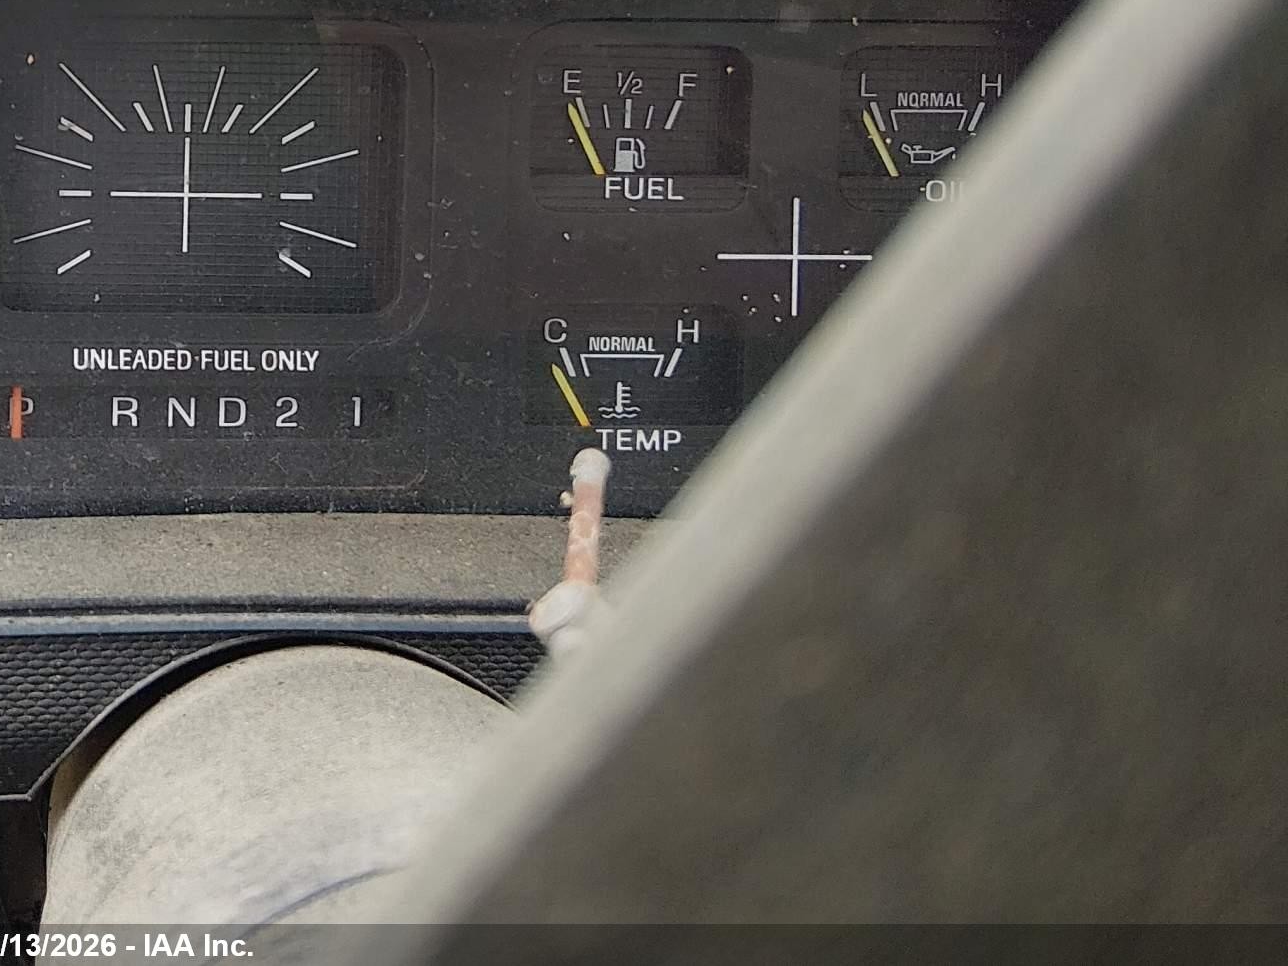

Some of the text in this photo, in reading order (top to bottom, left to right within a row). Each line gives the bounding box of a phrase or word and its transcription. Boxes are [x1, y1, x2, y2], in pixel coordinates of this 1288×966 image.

[563, 69, 582, 94] E
[678, 73, 698, 97] F
[860, 73, 878, 97] L
[980, 73, 1002, 98] H
[897, 92, 964, 109] NORMAL
[605, 176, 684, 201] FUEL
[544, 318, 568, 343] C
[677, 319, 699, 343] H
[588, 336, 656, 352] NORMAL
[73, 348, 320, 372] UNLEADED FUEL ONLY
[111, 396, 138, 427] R
[167, 397, 196, 428] N
[218, 397, 247, 427] D
[275, 396, 298, 427] 2
[595, 428, 682, 452] TEMP
